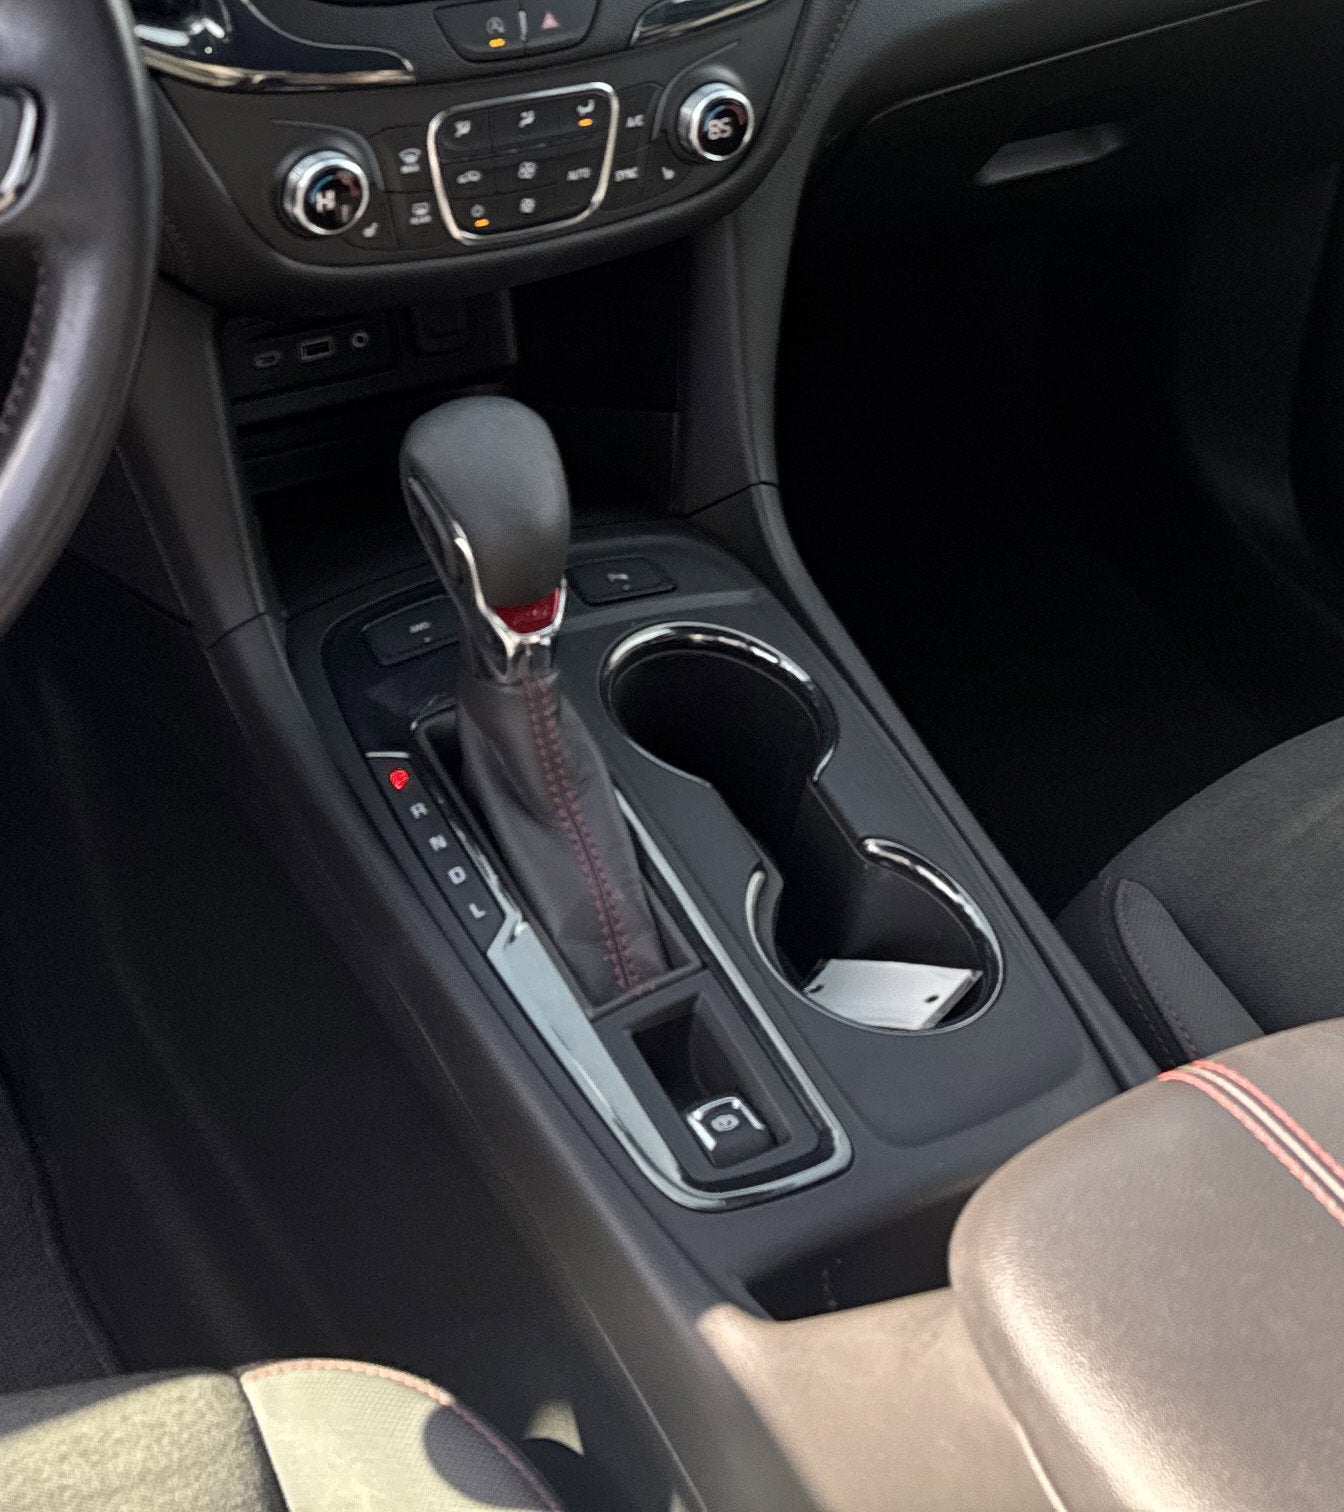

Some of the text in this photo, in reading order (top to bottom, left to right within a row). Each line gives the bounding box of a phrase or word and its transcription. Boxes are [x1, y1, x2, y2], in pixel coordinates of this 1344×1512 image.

[707, 116, 733, 141] 85
[409, 801, 429, 820] R
[447, 865, 468, 885] D
[468, 902, 487, 920] L
